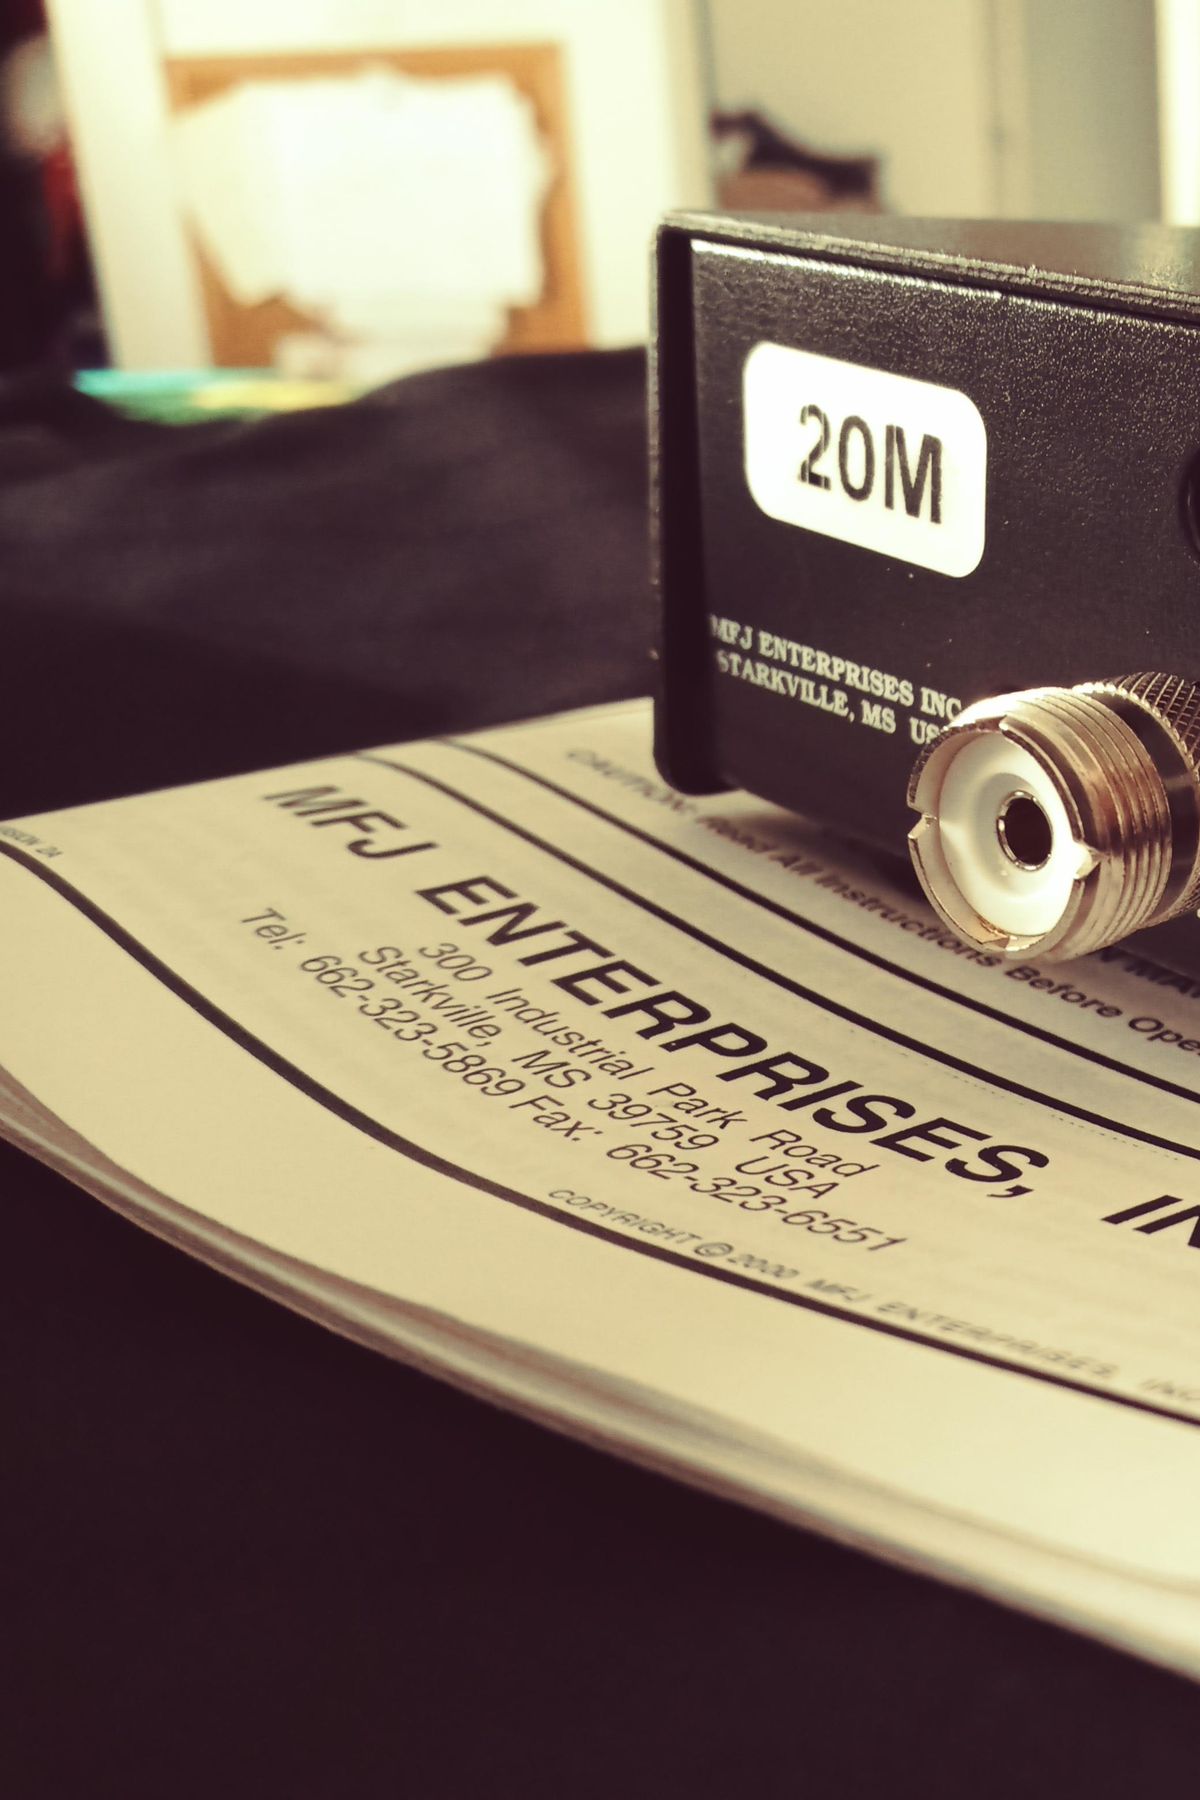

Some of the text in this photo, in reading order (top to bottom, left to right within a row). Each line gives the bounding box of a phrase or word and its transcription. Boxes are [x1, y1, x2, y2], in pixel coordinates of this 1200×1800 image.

[799, 404, 942, 524] 20M
[710, 614, 753, 650] MFJ
[759, 630, 914, 706] ENTERPRISES
[716, 650, 940, 744] STARKVILLE, MS US
[260, 785, 438, 860] MFJ
[414, 874, 1050, 1199] ENTERPRISES,
[813, 871, 1002, 967] Instructions
[1004, 965, 1122, 1019] Before
[241, 907, 907, 1252] Tel: 662-323-5869 Fax: 662-323-6551
[358, 945, 839, 1200] Starkville, MS 39759 USA
[418, 942, 880, 1178] 300 Industrial Park Road
[547, 1189, 702, 1245] COPYRIGHT
[804, 1277, 873, 1303] MFJ
[876, 1300, 1121, 1380] ENTERPRISES
